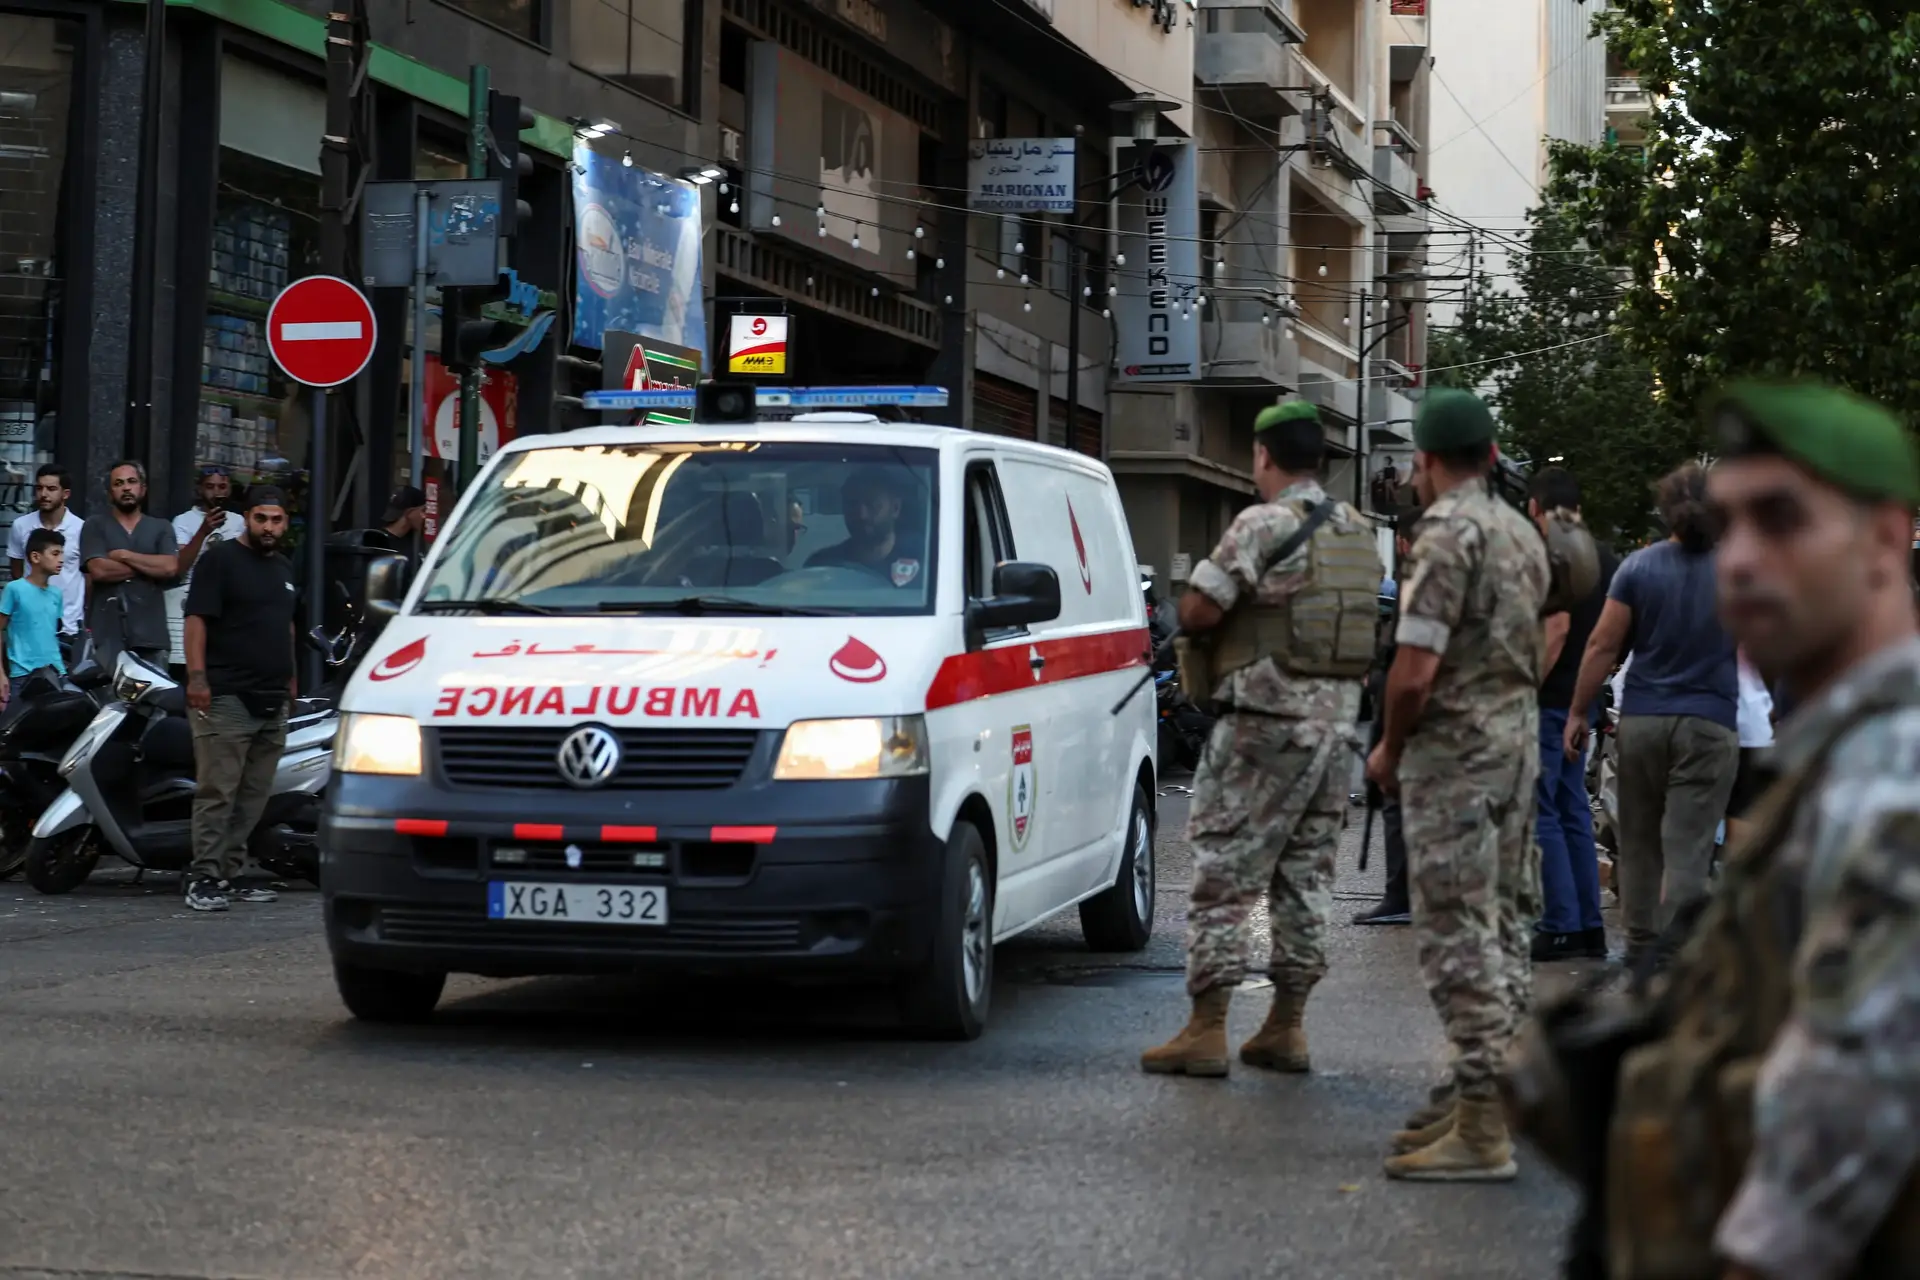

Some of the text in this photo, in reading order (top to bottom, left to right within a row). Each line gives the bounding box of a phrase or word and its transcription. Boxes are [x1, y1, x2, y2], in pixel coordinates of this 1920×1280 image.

[981, 184, 1067, 197] MARIGNAN
[1145, 197, 1170, 356] WEEKEND
[473, 639, 778, 668] إسعاف
[510, 885, 658, 920] XGA 332
